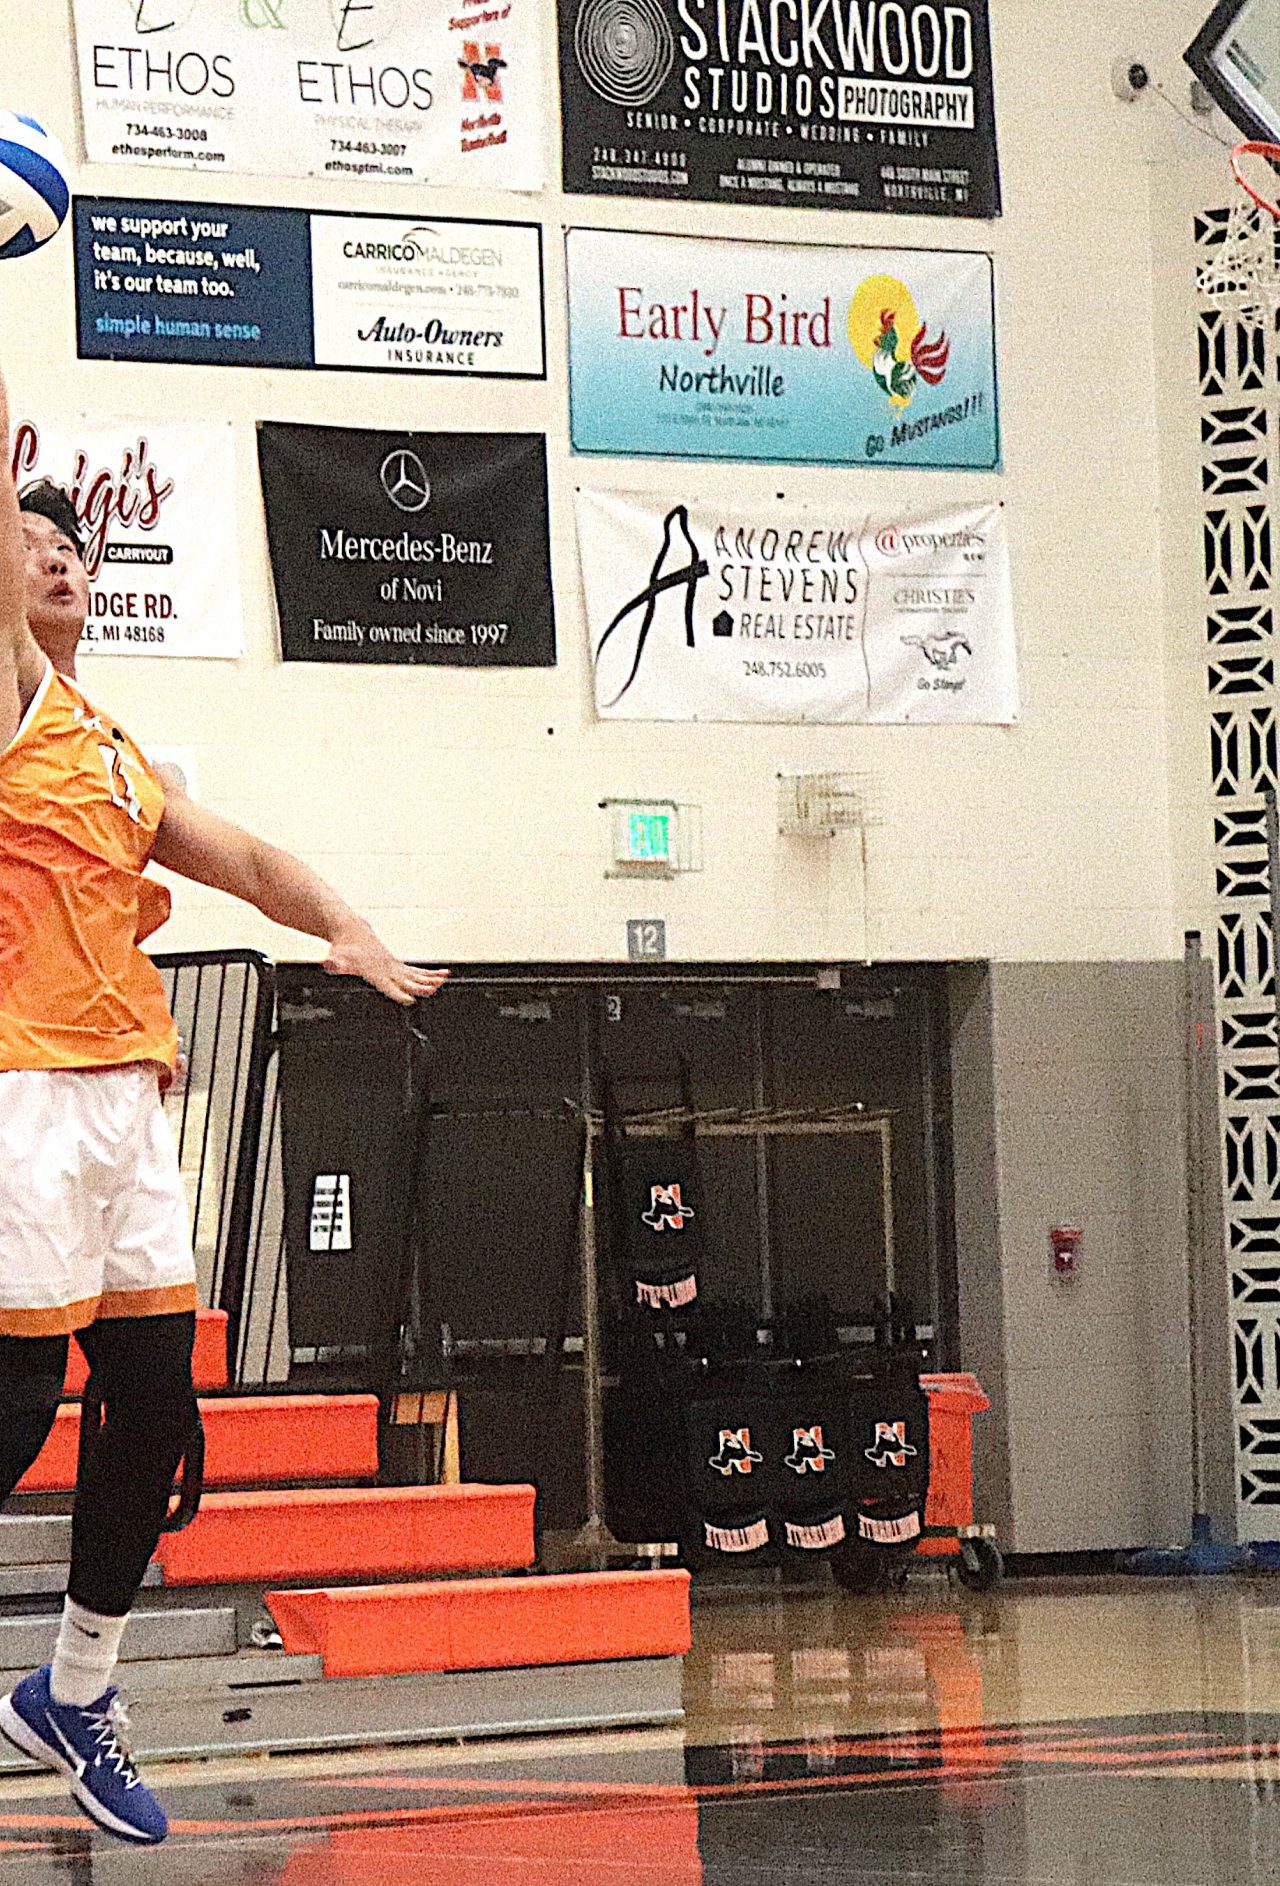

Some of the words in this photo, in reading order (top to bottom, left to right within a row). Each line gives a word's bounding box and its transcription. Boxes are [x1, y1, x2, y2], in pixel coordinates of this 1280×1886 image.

[93, 45, 235, 97] ETHOS
[297, 60, 433, 111] ETHOS
[683, 66, 835, 118] STUDIOS
[843, 85, 968, 121] PHOTOGRAPHY
[126, 123, 208, 142] 734-463-3008
[626, 111, 677, 131] SENIOR
[698, 116, 779, 138] CORPORATE
[800, 124, 860, 143] WEDDING
[880, 129, 929, 148] FAMILY
[112, 143, 226, 163] ethosperform.com
[330, 138, 407, 157] 734-463-3007
[324, 160, 413, 176] ethosptmi.com
[91, 216, 117, 233] we
[120, 217, 188, 239] support
[190, 221, 228, 242] your
[93, 241, 141, 266] team,
[145, 243, 218, 270] because,
[222, 249, 261, 273] well,
[94, 269, 120, 291] it's
[124, 276, 153, 292] our
[156, 274, 198, 295] team
[201, 276, 235, 297] too.
[96, 311, 151, 339] simple
[155, 315, 210, 337] human
[214, 322, 261, 341] sense
[357, 316, 503, 347] Auto-Owners
[616, 286, 728, 357] Early
[745, 293, 833, 349] Bird
[388, 349, 475, 366] INSURANCE
[660, 363, 785, 397] Northville
[107, 546, 169, 562] CARRYOUT
[320, 529, 493, 565] Mercedes-Benz
[380, 578, 400, 602] of
[402, 577, 443, 602] Novi
[719, 564, 857, 604] STEVENS
[144, 592, 179, 620] RD.
[102, 624, 121, 641] MI
[124, 625, 165, 643] 48168
[314, 619, 366, 647] Family
[370, 622, 421, 645] owned
[425, 625, 466, 645] since
[471, 624, 509, 646] 1997
[740, 612, 785, 639] REAL
[793, 613, 855, 640] ESTATE
[742, 660, 826, 678] 248.752.6005
[634, 925, 659, 954] 12
